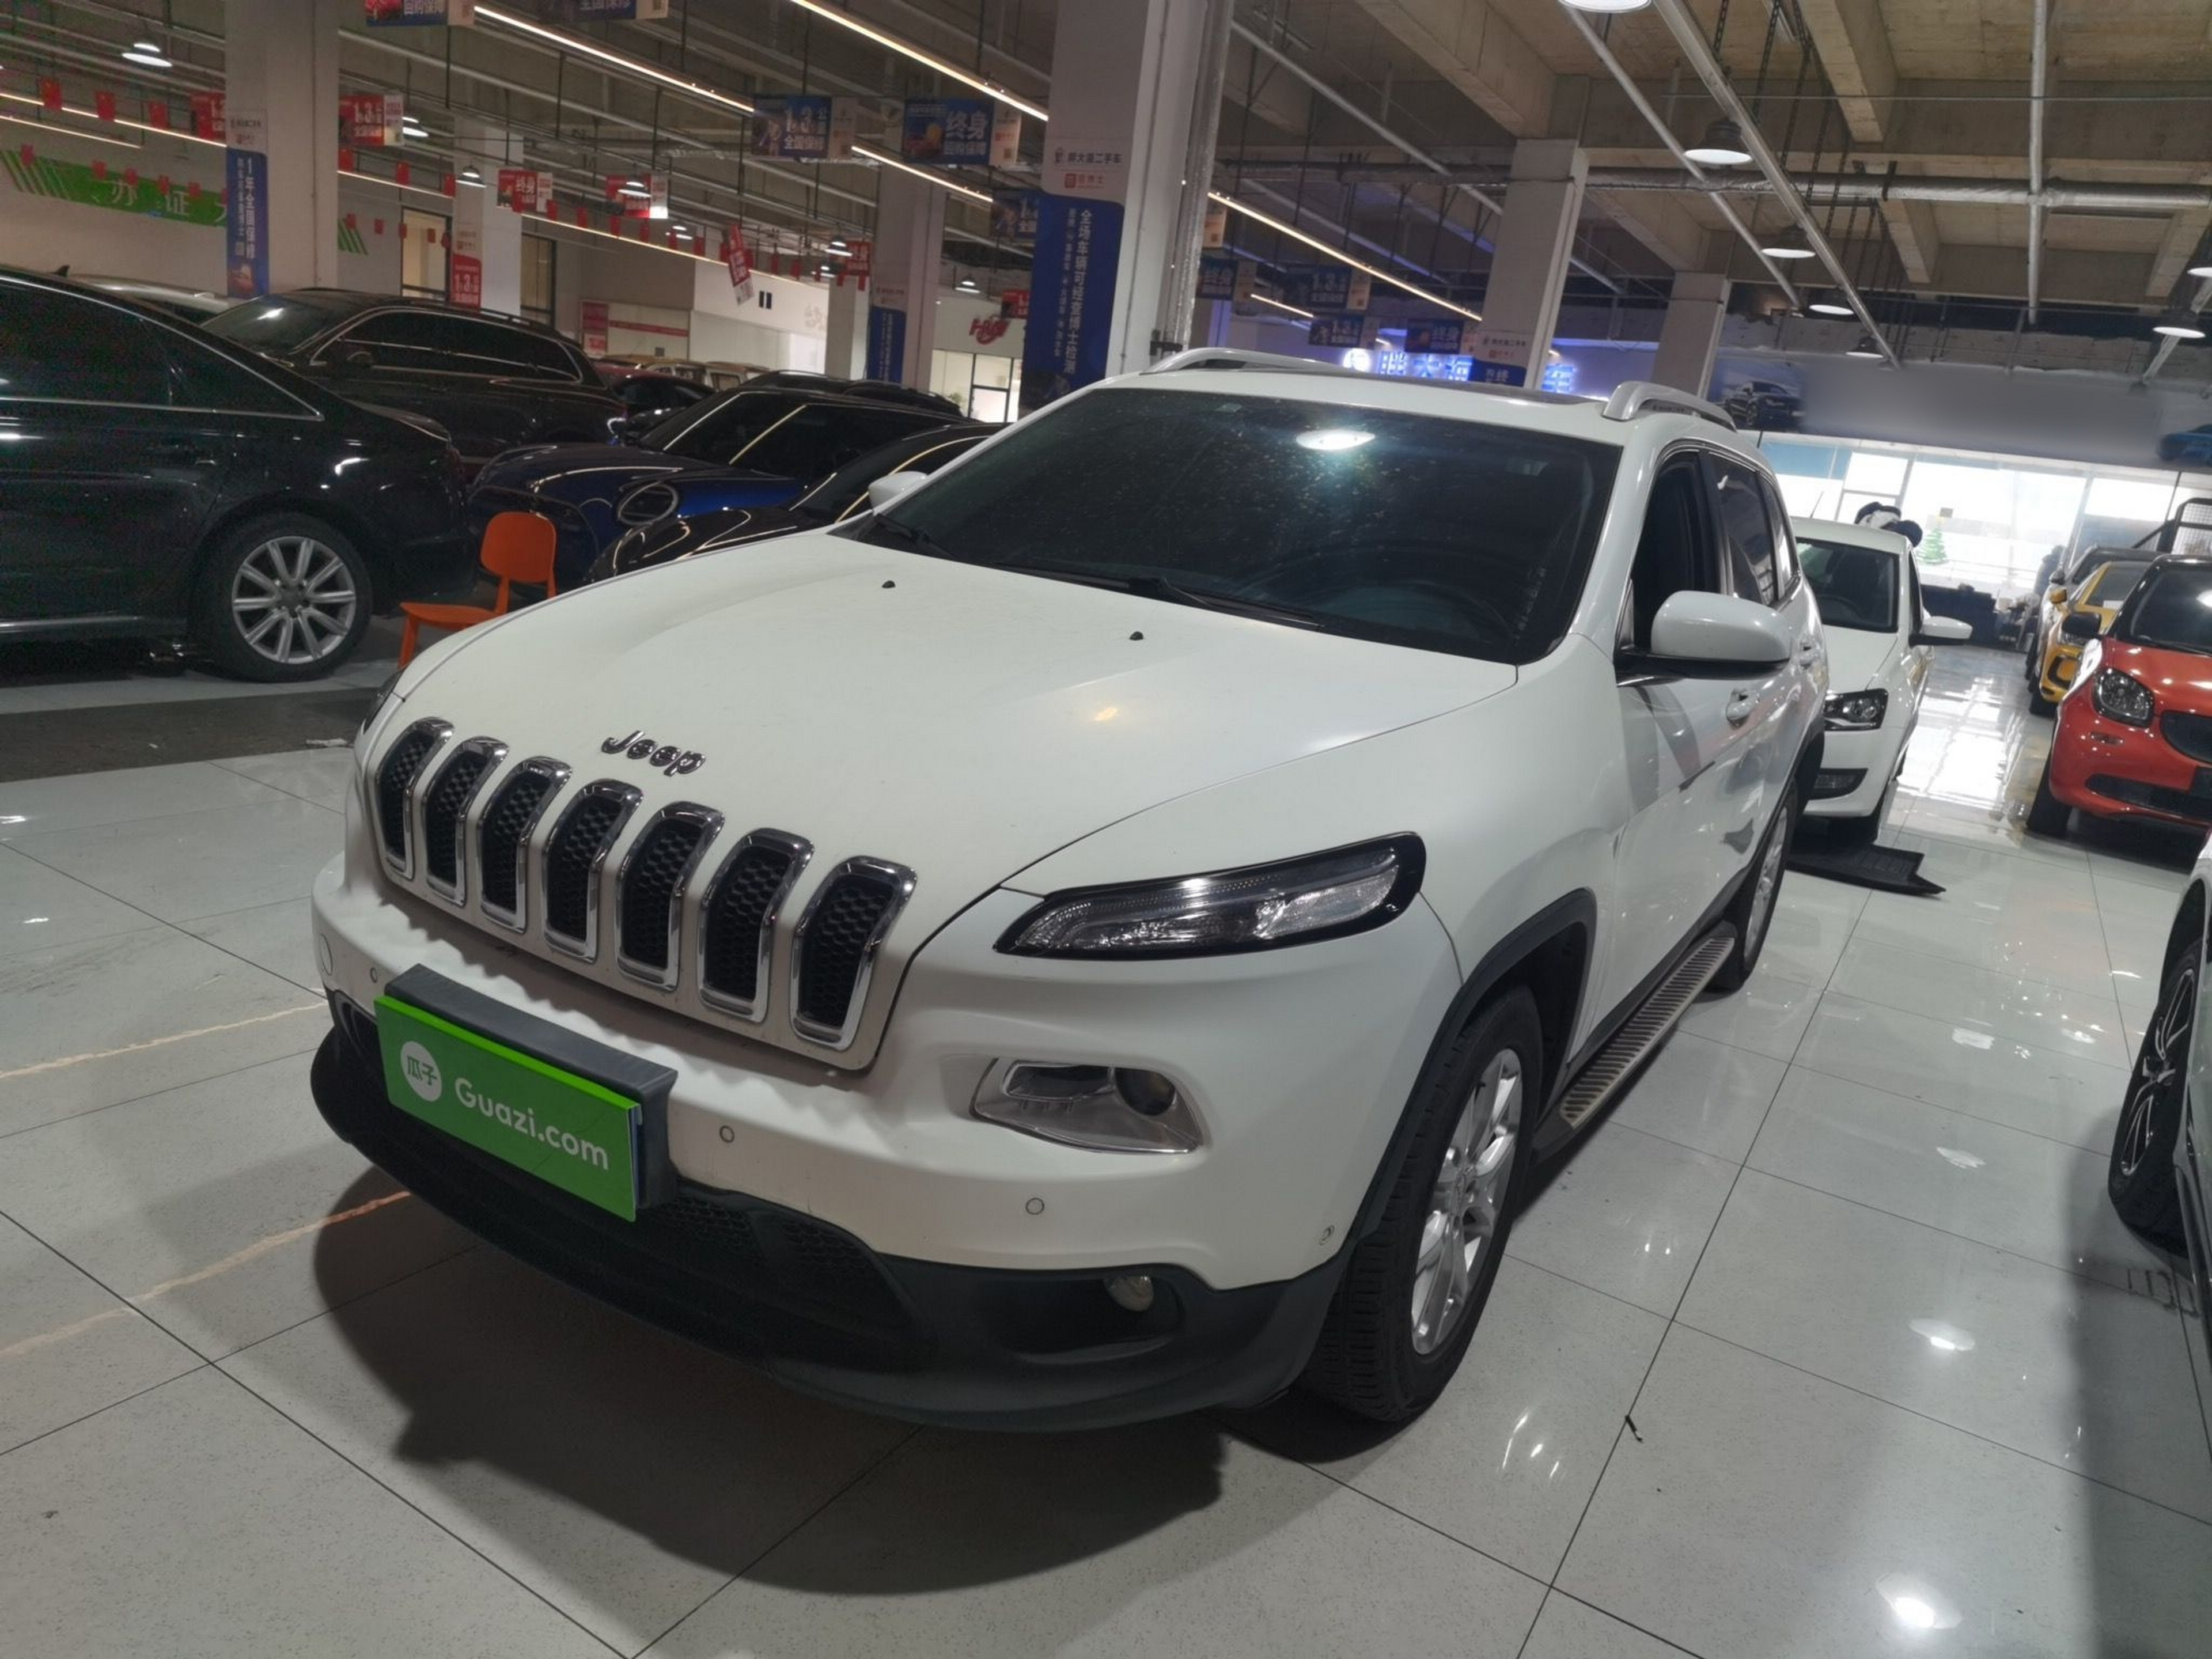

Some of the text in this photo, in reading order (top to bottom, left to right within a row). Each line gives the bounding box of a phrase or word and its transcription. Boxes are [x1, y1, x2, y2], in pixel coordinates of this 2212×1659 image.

[945, 110, 987, 139] 终身
[601, 730, 707, 777] Jeep
[406, 1055, 438, 1086] 瓜子
[454, 1077, 609, 1171] Guazi.com
